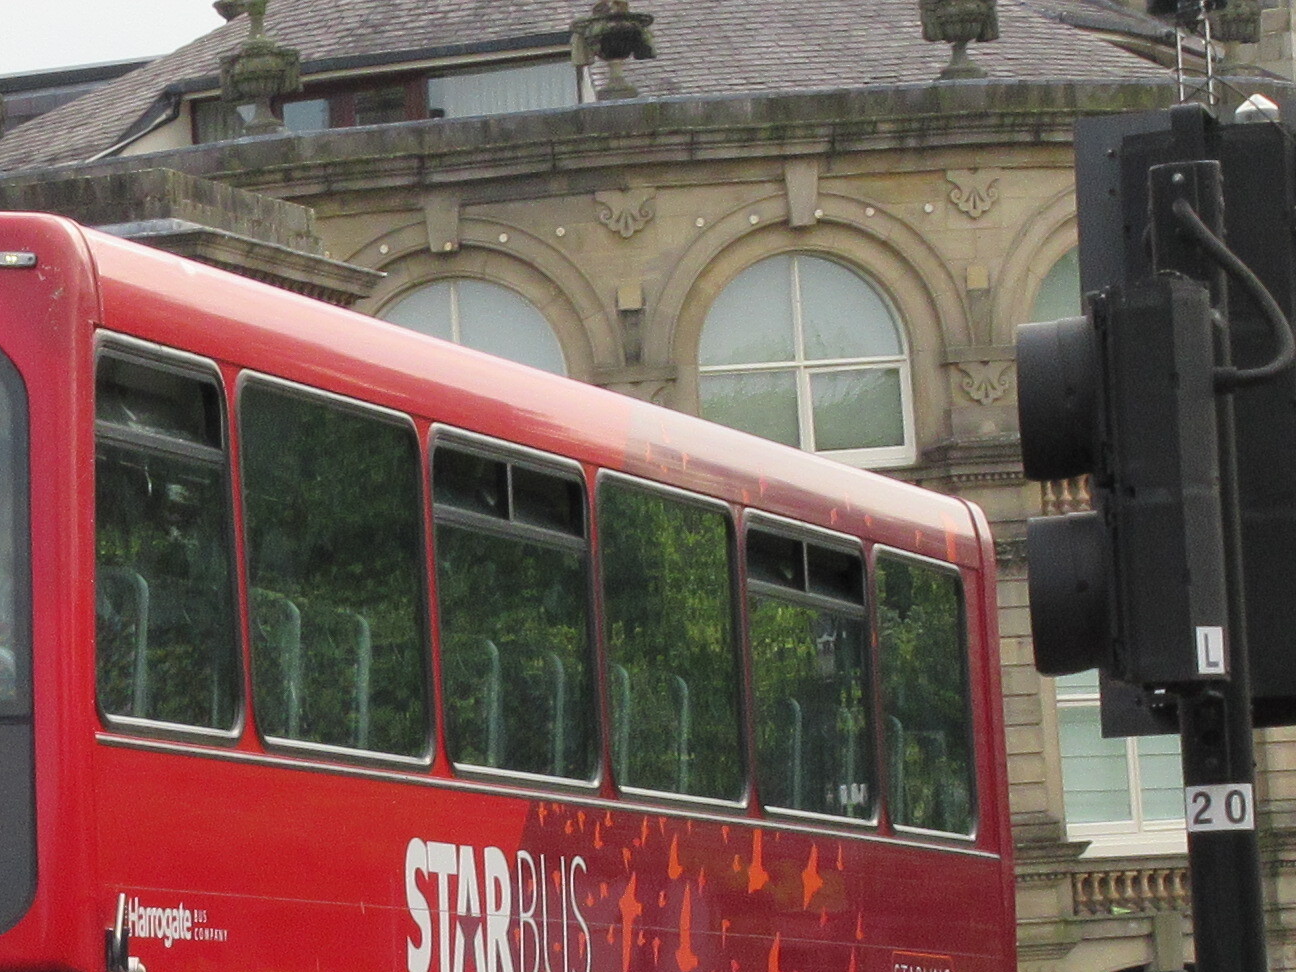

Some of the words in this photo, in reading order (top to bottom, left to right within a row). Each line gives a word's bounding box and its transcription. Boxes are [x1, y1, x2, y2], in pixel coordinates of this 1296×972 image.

[1204, 633, 1220, 668] L
[129, 896, 192, 948] Harrogate
[194, 909, 207, 923] BUS
[194, 927, 228, 942] COMPANY
